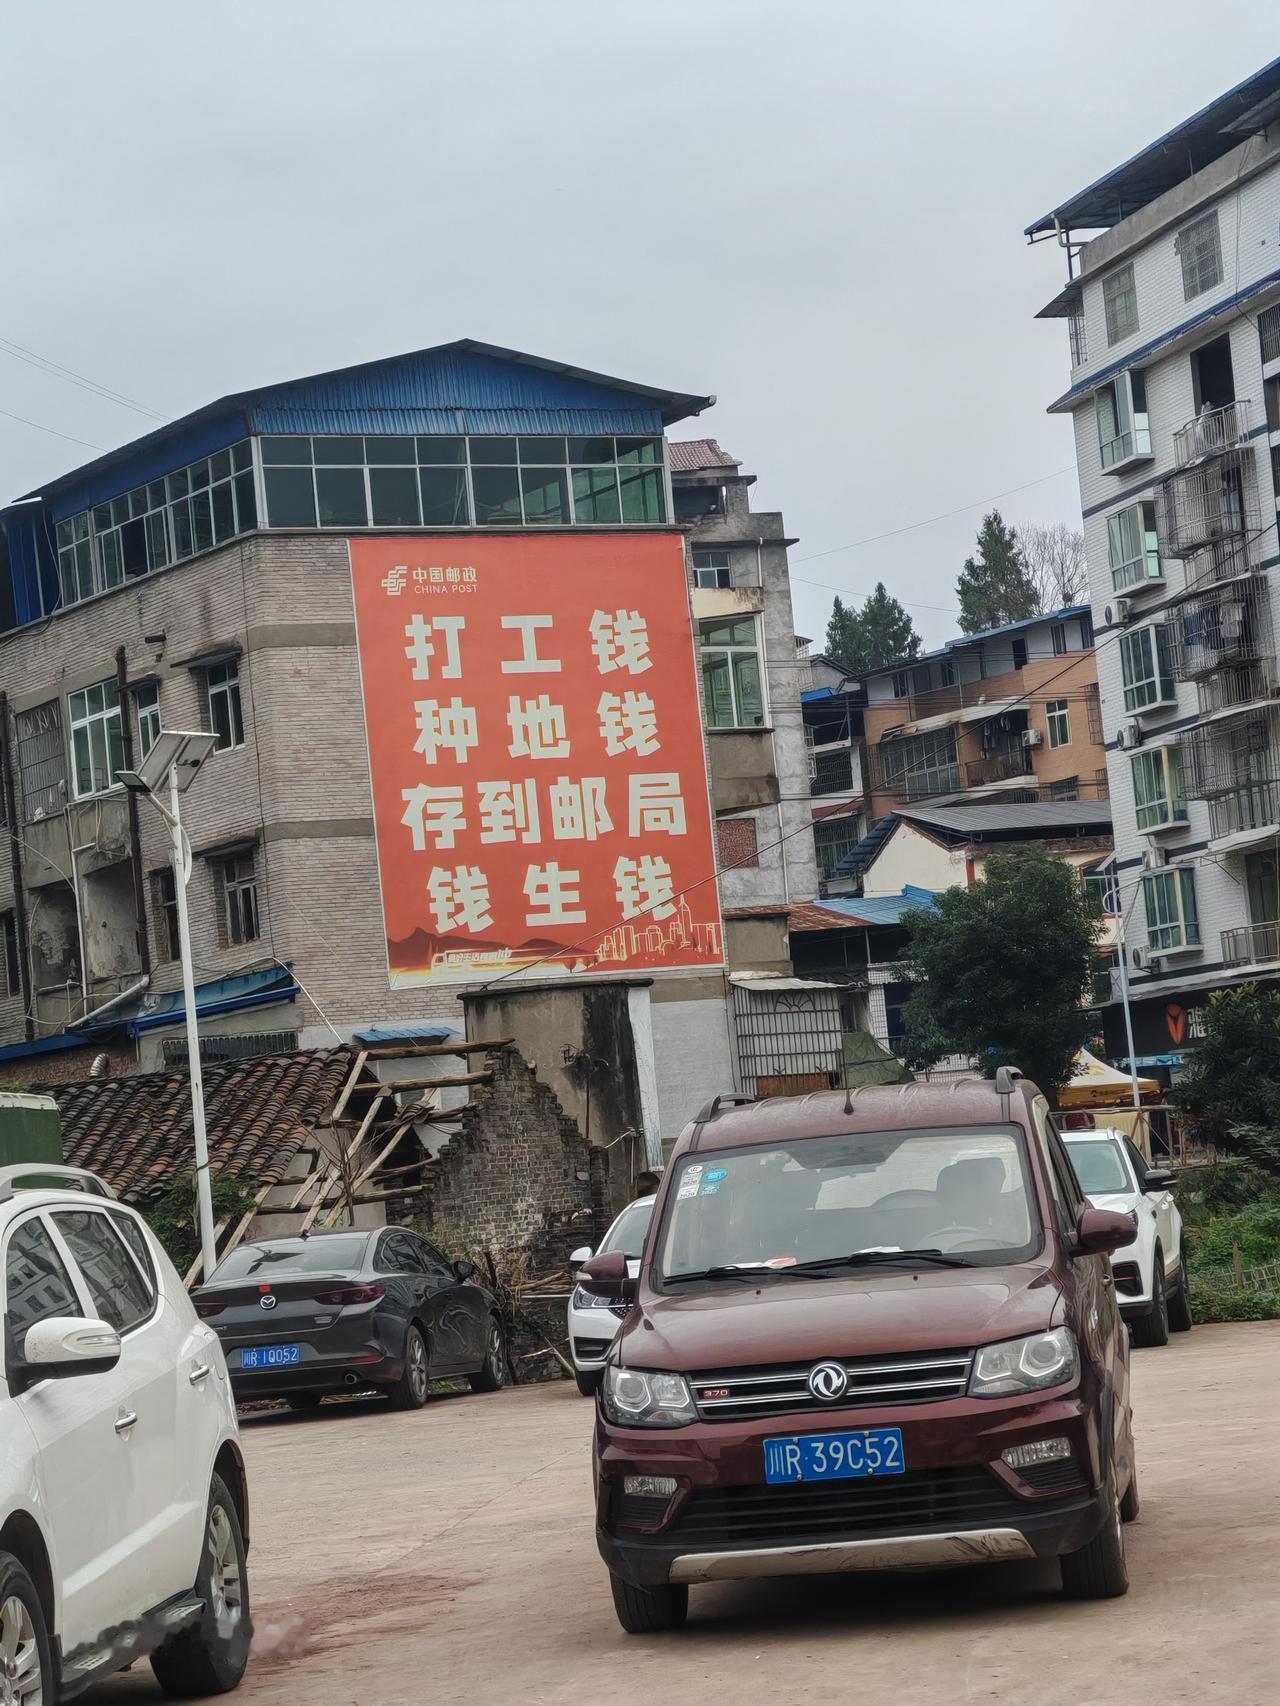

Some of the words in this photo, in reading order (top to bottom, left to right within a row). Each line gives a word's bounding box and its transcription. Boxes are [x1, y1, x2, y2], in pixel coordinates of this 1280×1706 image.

[412, 566, 478, 584] 中国邮政
[414, 585, 449, 594] CHINA
[452, 584, 478, 593] POST
[404, 609, 654, 681] 打工钱
[412, 690, 661, 765] 种地钱
[400, 772, 687, 851] 存到邮局
[426, 854, 678, 934] 钱生钱
